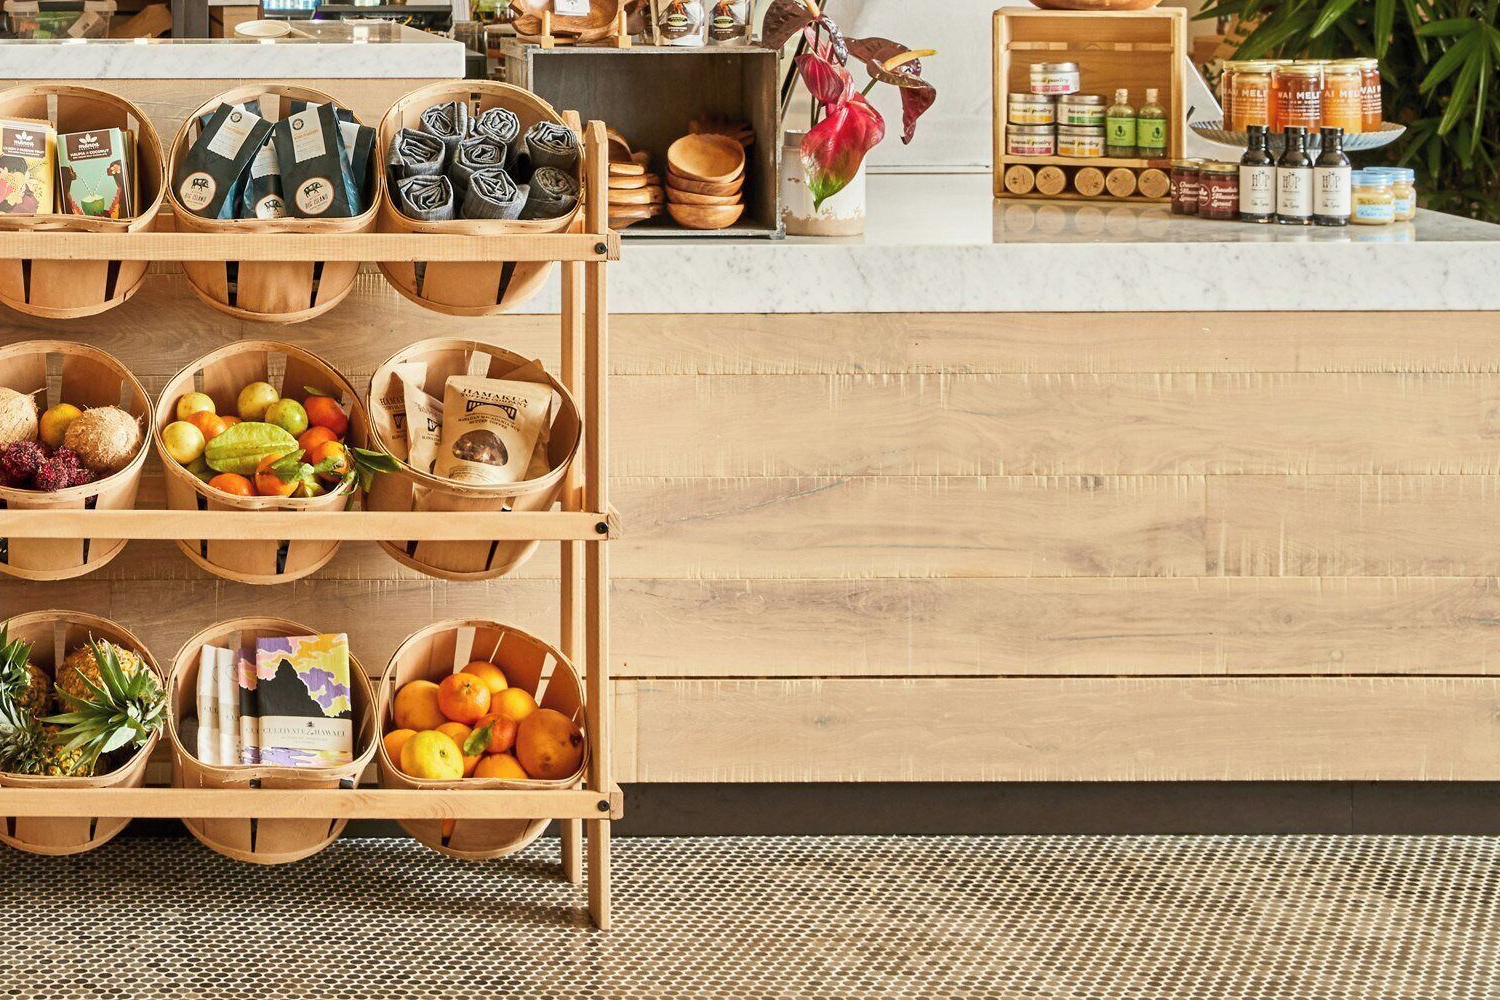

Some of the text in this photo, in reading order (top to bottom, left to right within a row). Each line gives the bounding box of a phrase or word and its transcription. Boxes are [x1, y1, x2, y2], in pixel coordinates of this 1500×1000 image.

[313, 195, 330, 208] ISLAND
[463, 388, 529, 404] HAMAKUA
[491, 397, 529, 408] COMPANY
